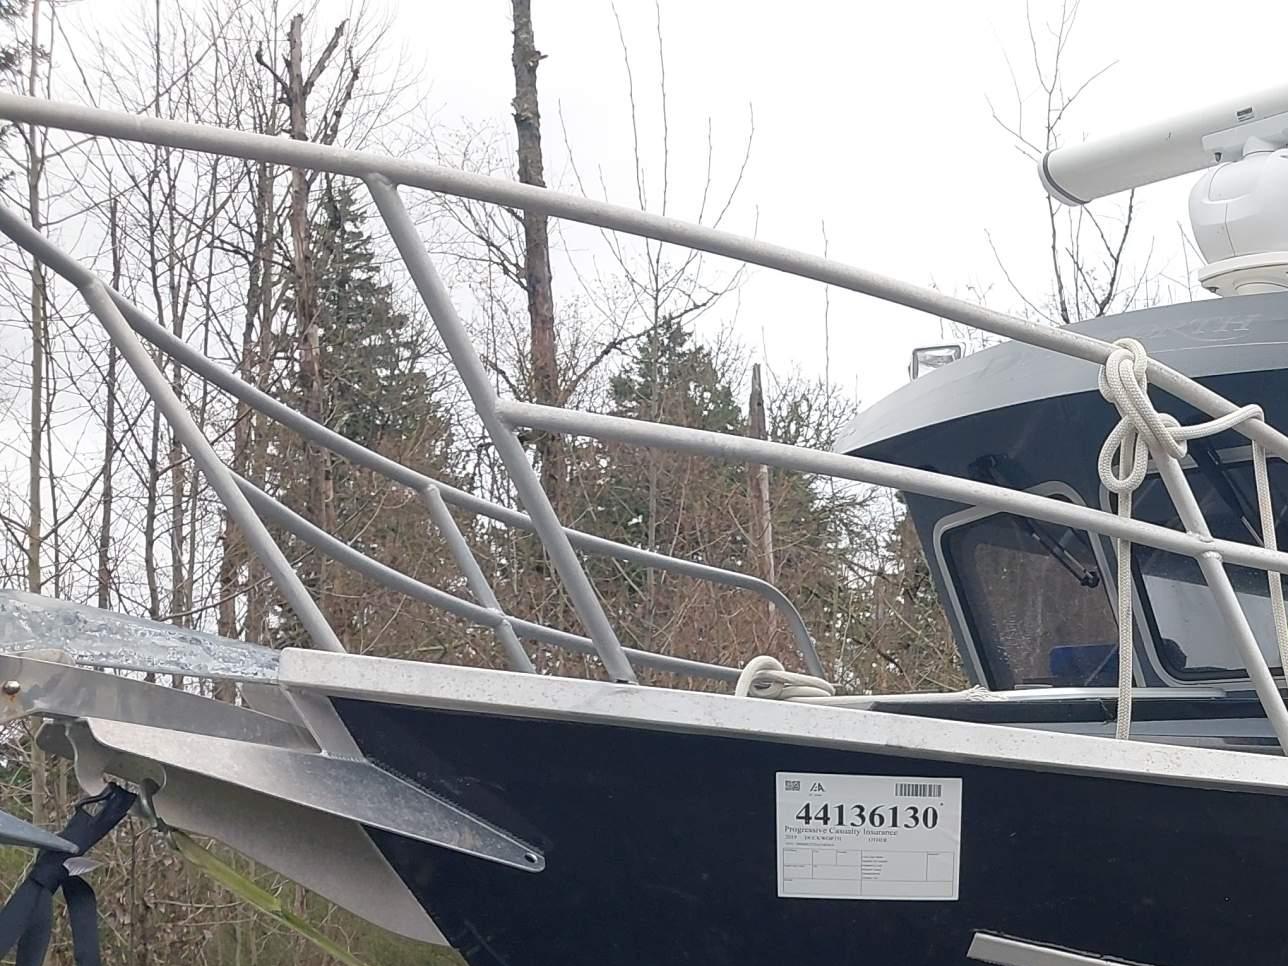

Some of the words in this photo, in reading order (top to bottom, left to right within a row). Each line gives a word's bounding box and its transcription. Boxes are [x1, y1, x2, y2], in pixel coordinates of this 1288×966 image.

[795, 802, 938, 829] 44136130
[784, 825, 827, 834] Progressive
[829, 827, 860, 836] Casualty
[863, 828, 898, 836] Insurance
